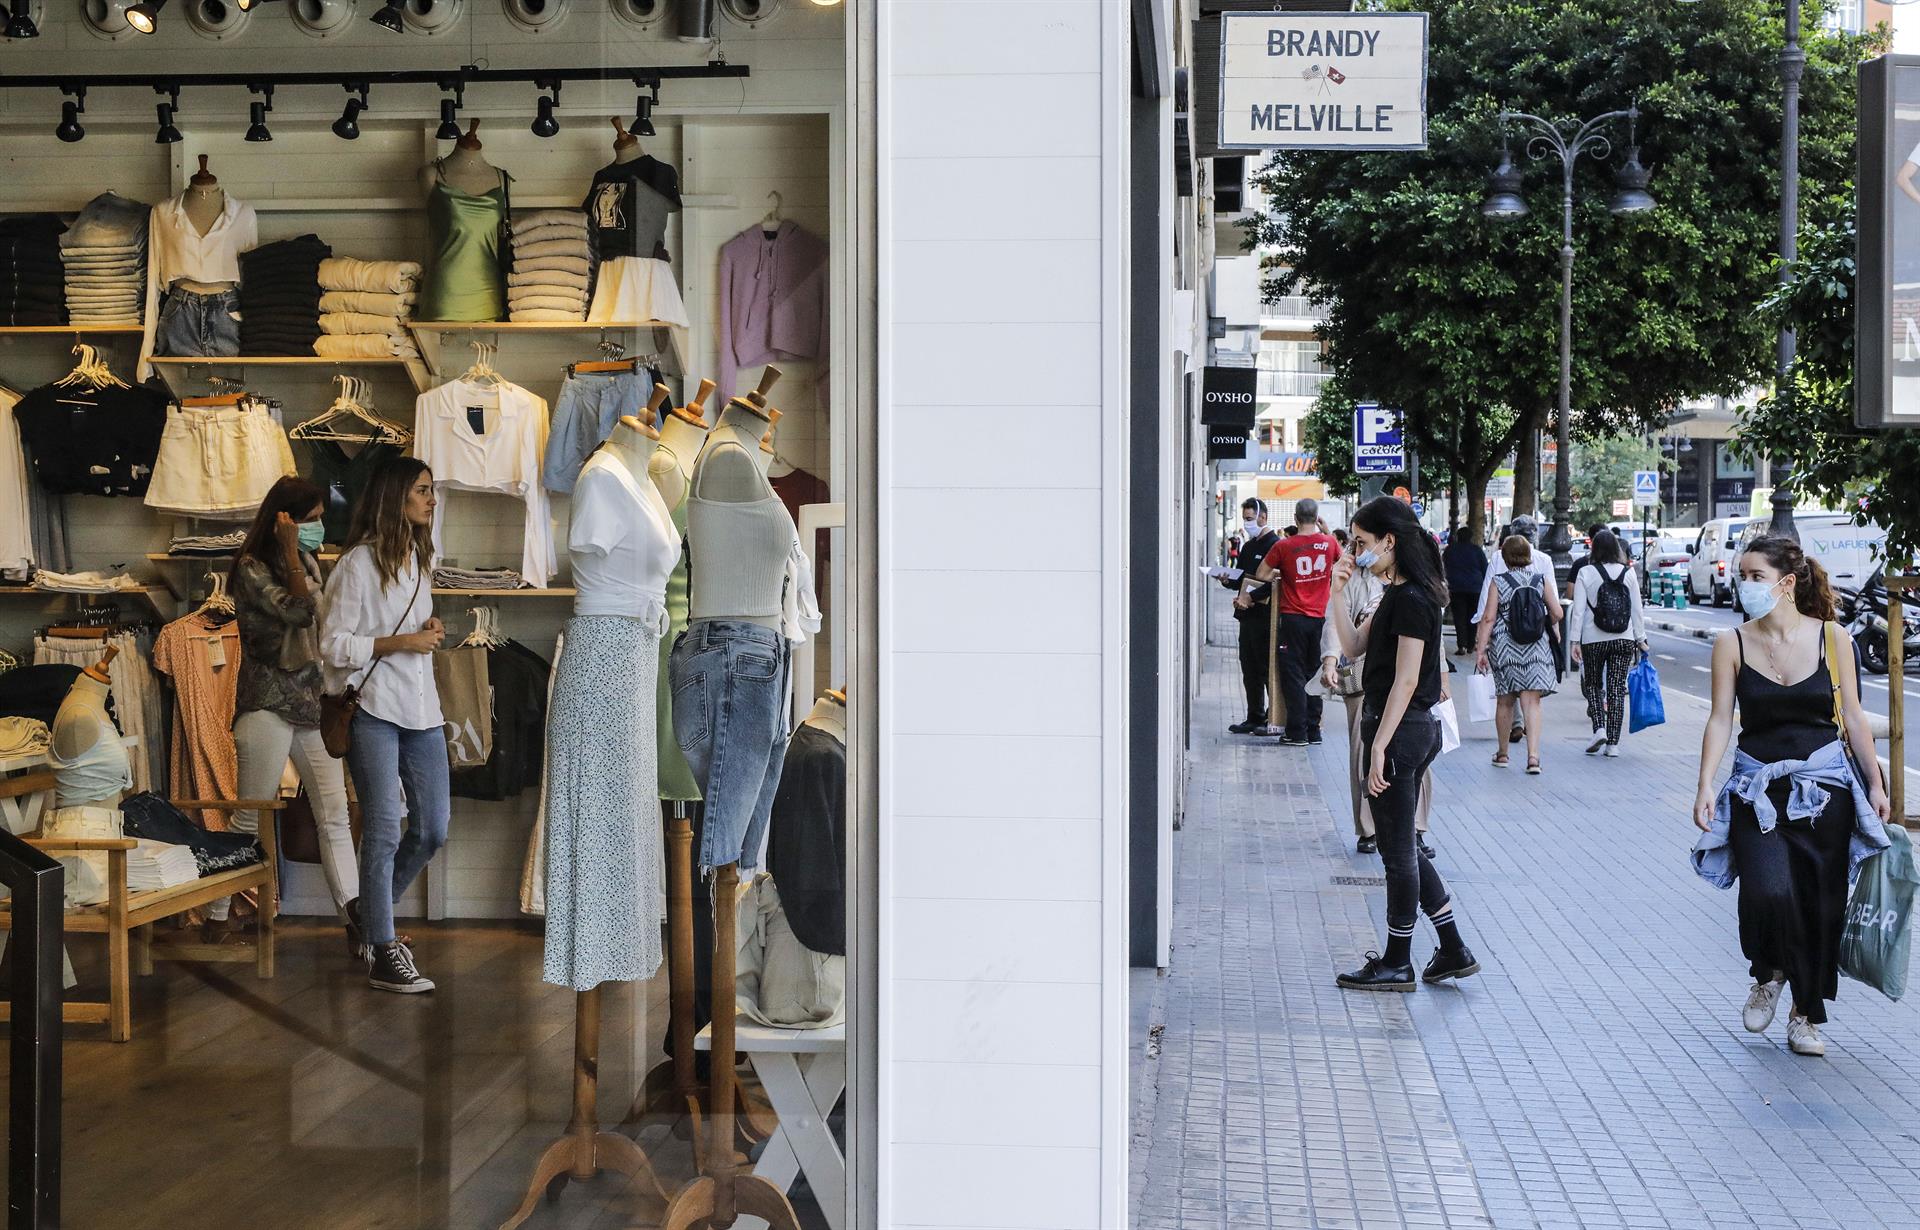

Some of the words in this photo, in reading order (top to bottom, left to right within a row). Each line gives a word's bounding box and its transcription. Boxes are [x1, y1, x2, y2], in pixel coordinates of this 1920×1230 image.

[1267, 30, 1380, 57] BRANDY
[1251, 104, 1394, 131] MELVILLE
[1206, 391, 1252, 403] OYSHO
[1363, 409, 1396, 443] P
[1212, 436, 1244, 444] OYSHO
[1831, 540, 1884, 549] LAFUENE
[1295, 554, 1327, 576] 04
